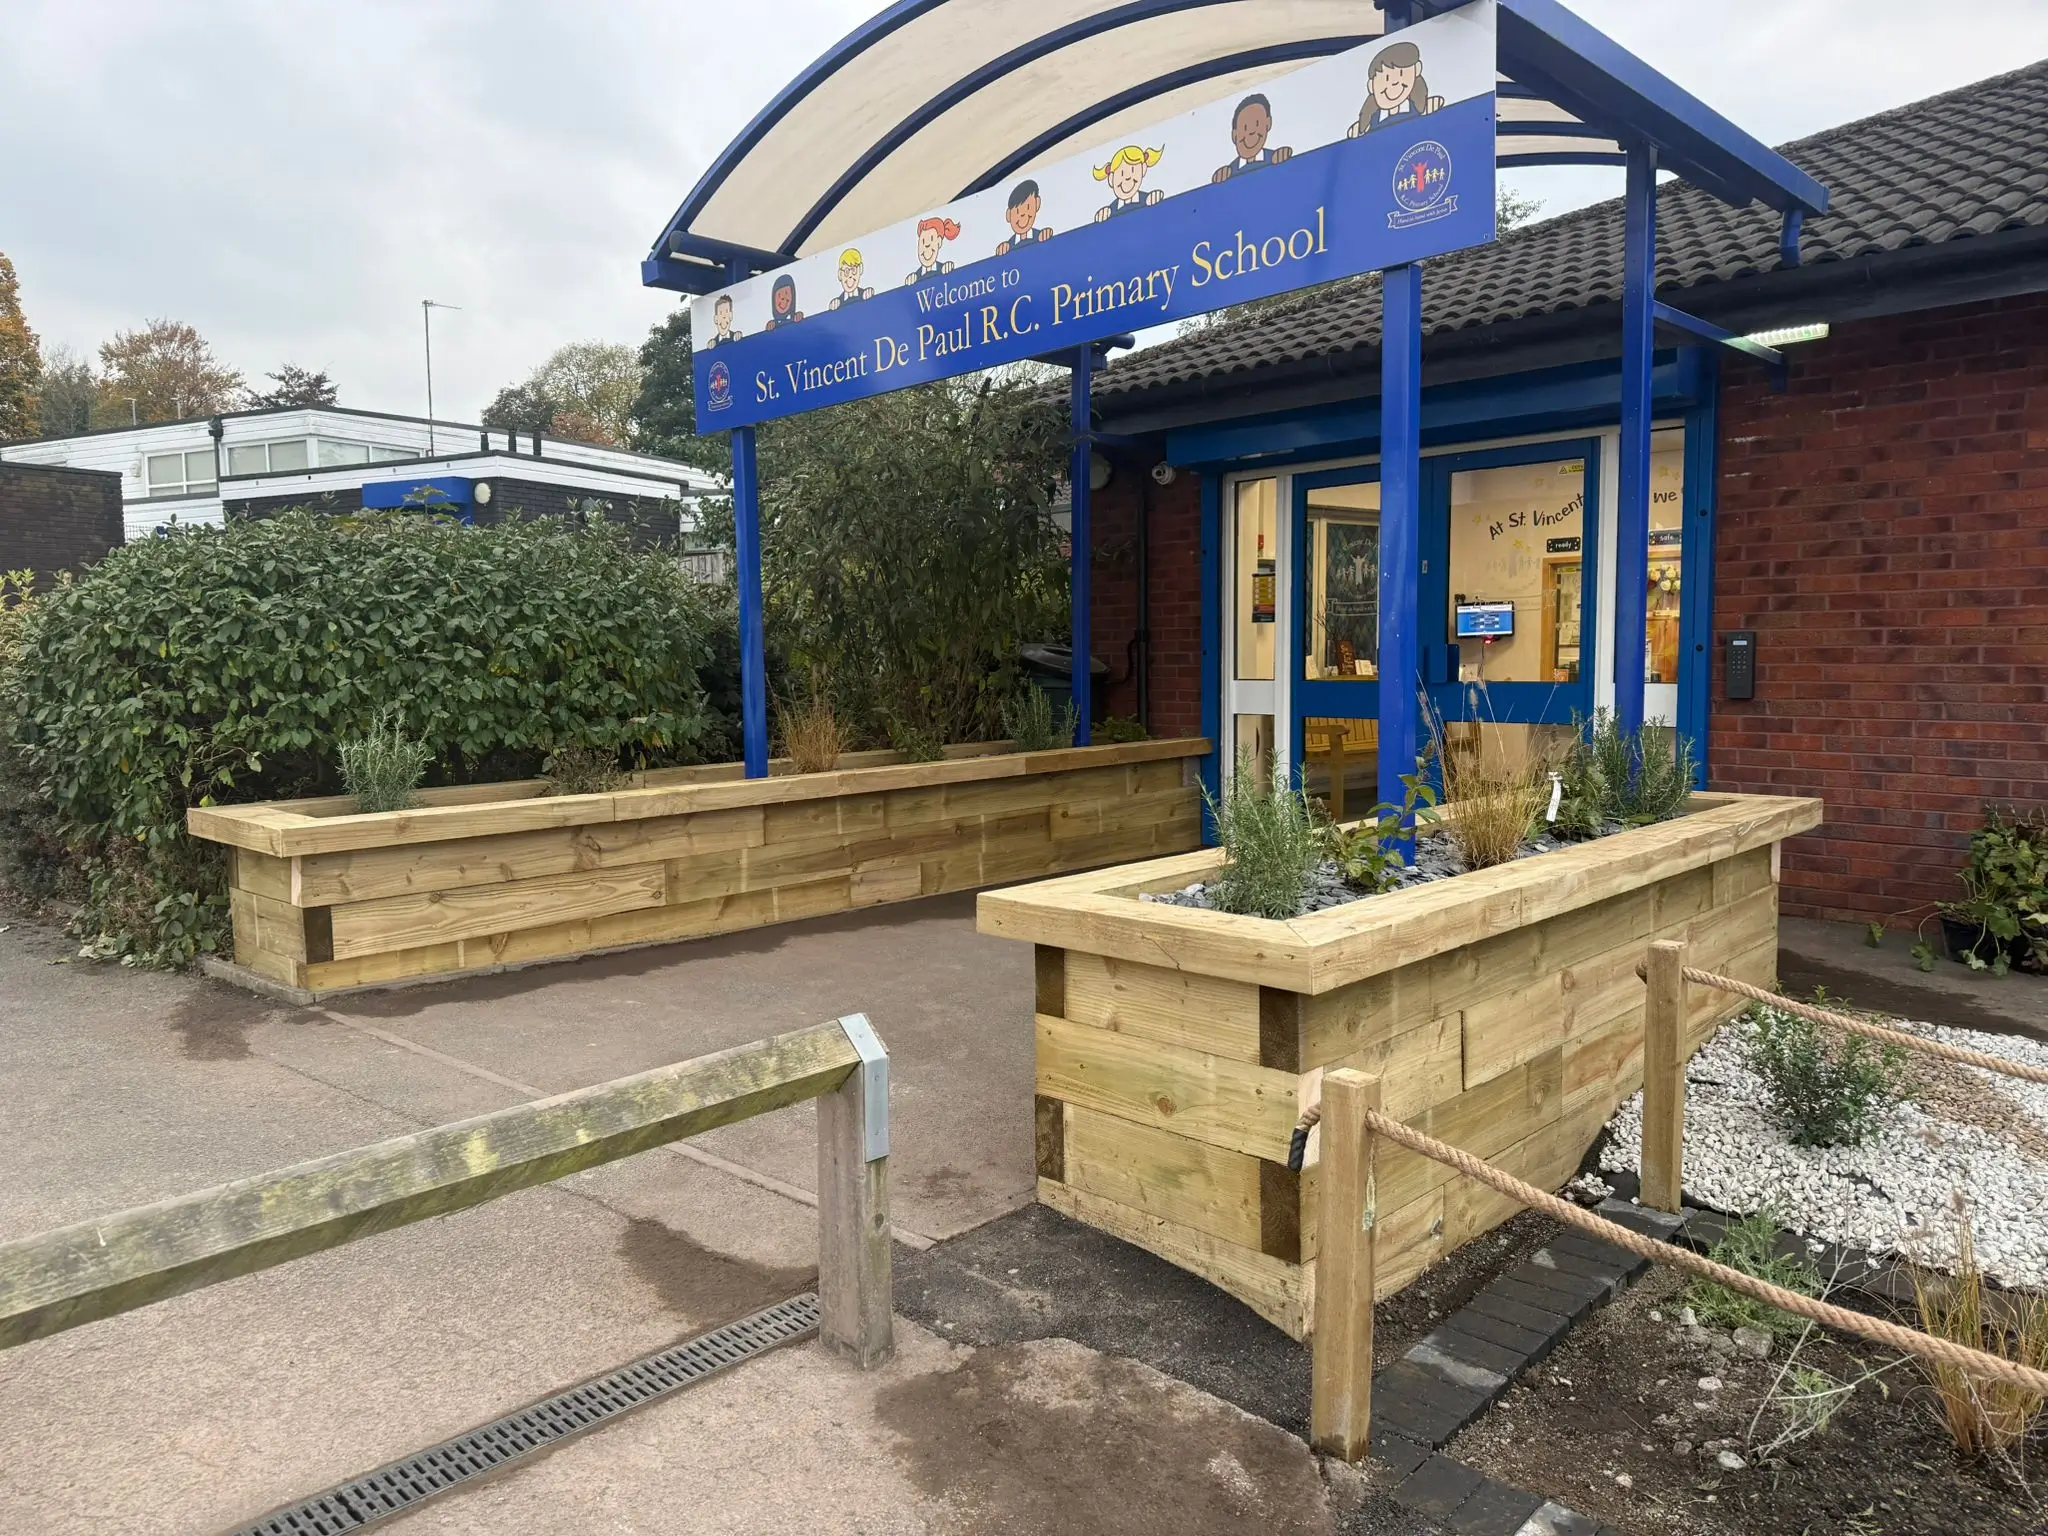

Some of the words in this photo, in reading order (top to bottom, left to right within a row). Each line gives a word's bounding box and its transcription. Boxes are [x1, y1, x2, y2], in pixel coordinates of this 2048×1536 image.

[756, 371, 780, 403] St.
[785, 351, 867, 395] Vincent
[874, 336, 910, 374] De
[917, 311, 972, 362] Paul
[980, 294, 1040, 345] R.C.
[1051, 265, 1180, 326] Primary
[1191, 206, 1328, 288] School
[916, 277, 996, 313] Welcome
[1001, 268, 1020, 287] to
[1489, 521, 1504, 540] At
[1509, 511, 1526, 527] St.
